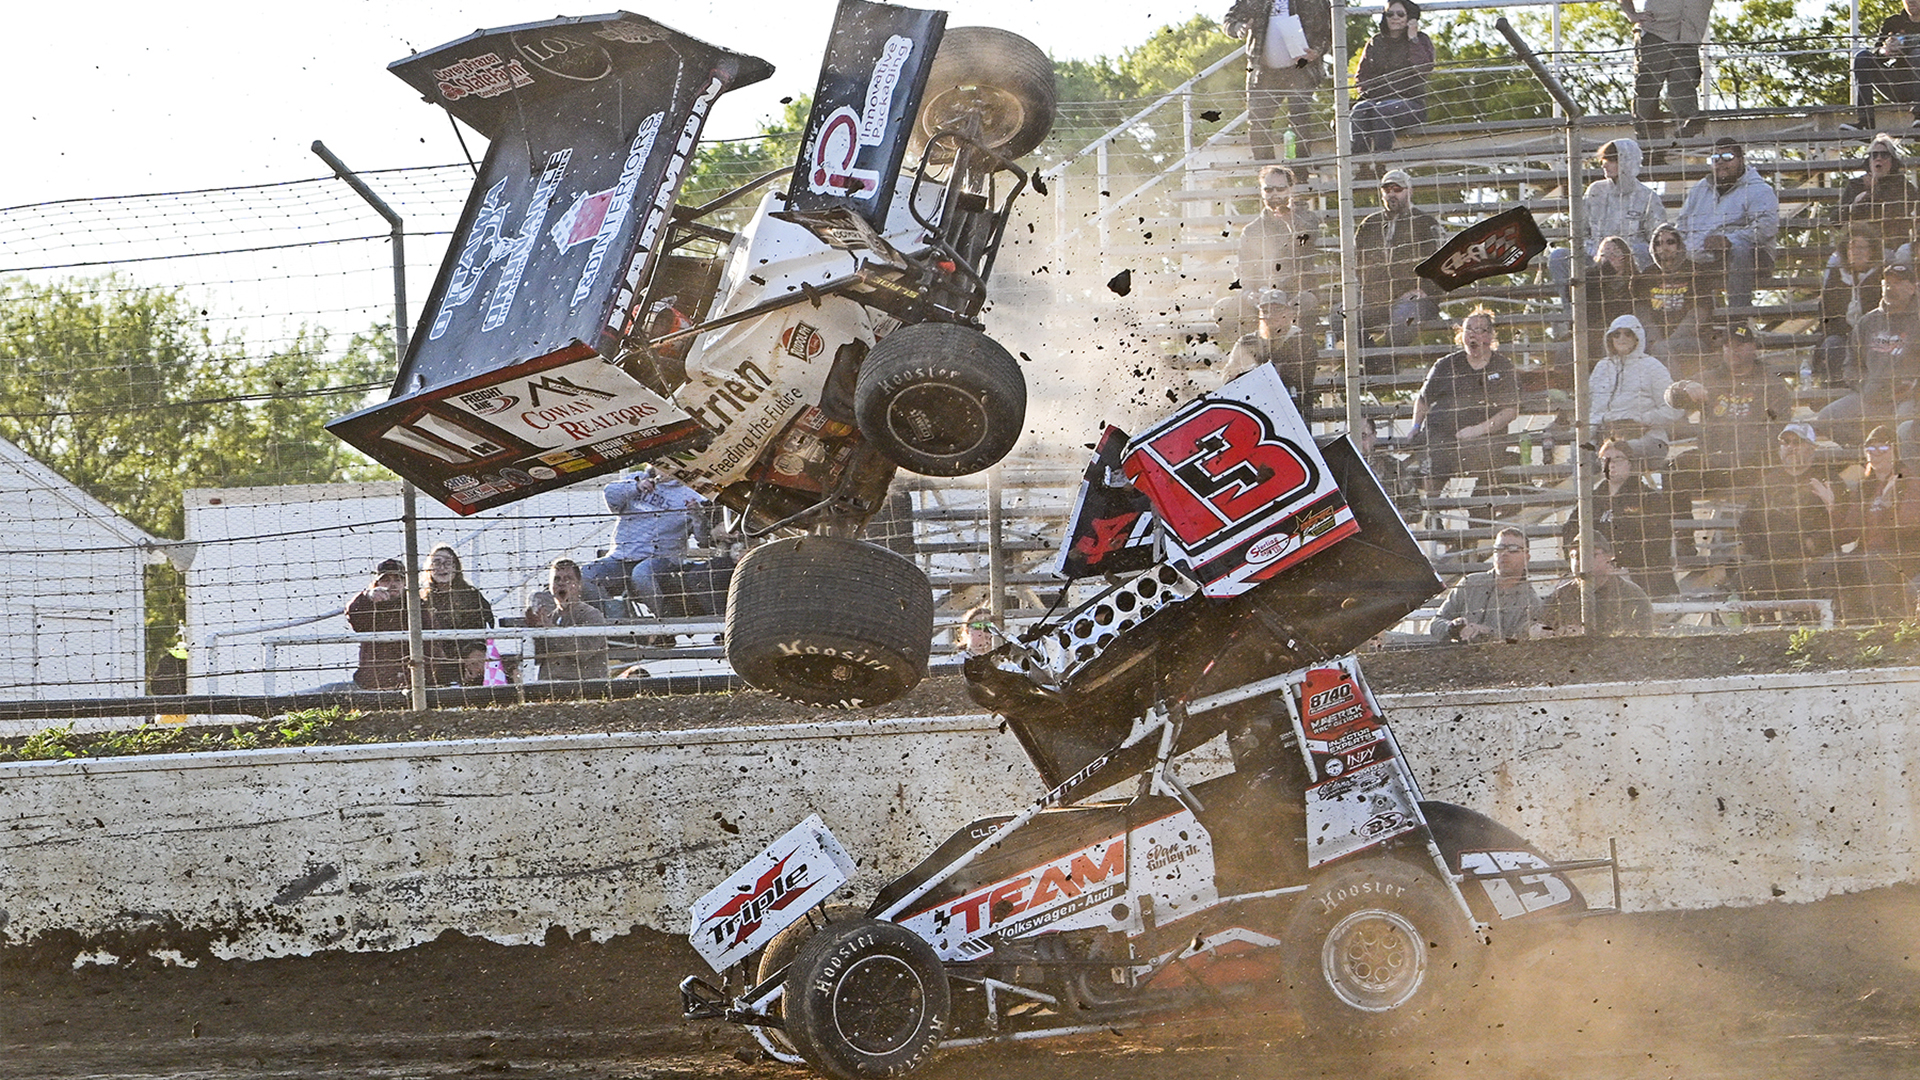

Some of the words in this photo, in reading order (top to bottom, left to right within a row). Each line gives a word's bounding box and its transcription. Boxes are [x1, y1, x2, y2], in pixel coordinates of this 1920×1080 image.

[861, 41, 897, 139] Innovative
[872, 45, 908, 139] Packaging
[606, 75, 723, 330] HARMON
[482, 149, 565, 327] ORDNANCE
[429, 177, 507, 338] OTTAWA
[789, 324, 811, 358] RUDOLPH
[459, 386, 504, 405] FREIGHT
[467, 400, 493, 412] LANE
[520, 400, 592, 431] COWAN
[559, 402, 659, 441] REALTORS
[708, 435, 758, 476] Feeding
[746, 414, 772, 440] the
[763, 385, 802, 421] Future
[590, 437, 627, 453] ENGINE
[1121, 400, 1318, 551] 13
[1310, 683, 1352, 709] 8740
[1310, 704, 1364, 729] MAVERICK
[1328, 728, 1370, 747] INJECTOR
[1329, 733, 1373, 753] EXPERTS
[1147, 843, 1179, 861] Dan
[951, 840, 1125, 934] TEAM
[1319, 881, 1406, 915] Hoosier
[1460, 850, 1572, 921] 13
[707, 863, 808, 945] Triple
